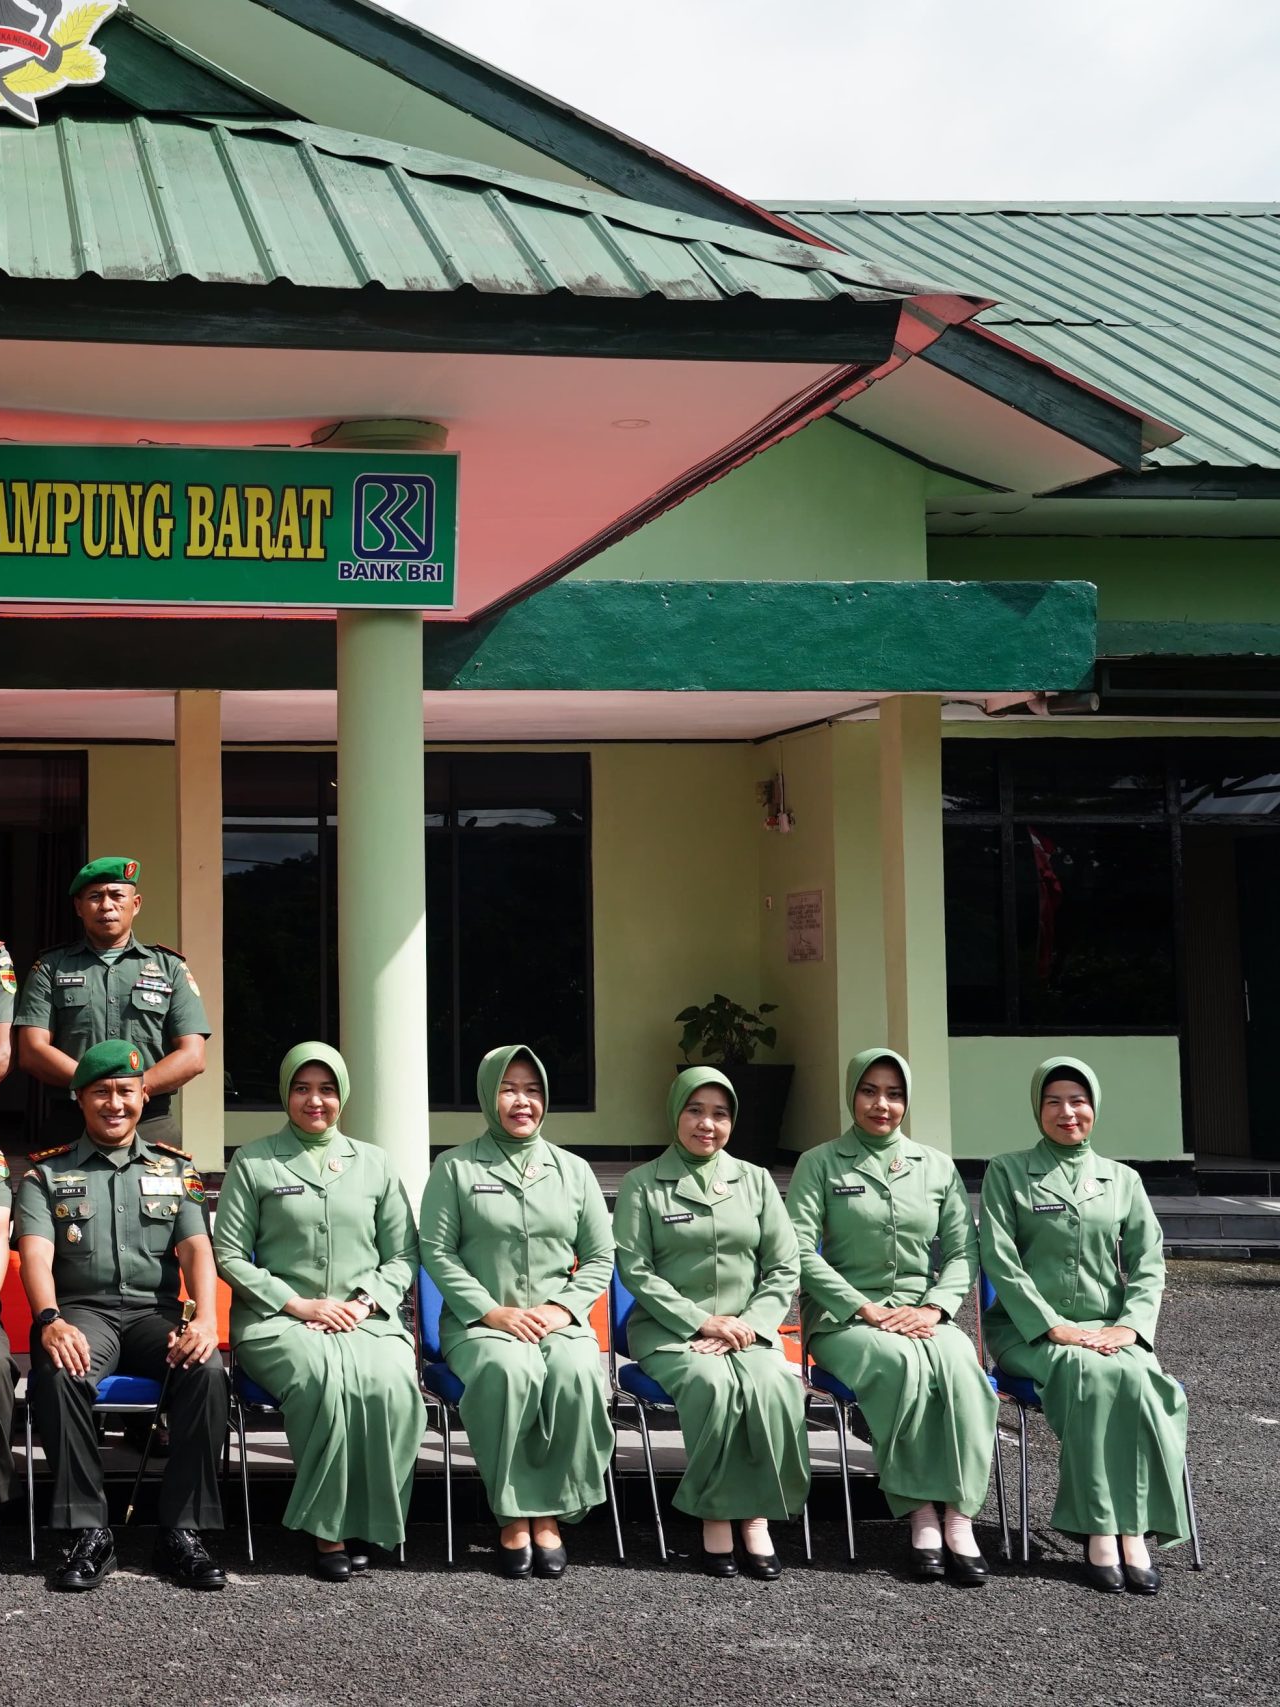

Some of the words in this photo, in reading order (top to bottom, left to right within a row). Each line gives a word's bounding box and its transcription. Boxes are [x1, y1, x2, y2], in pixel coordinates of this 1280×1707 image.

[184, 484, 332, 561] BARAT
[339, 561, 402, 580] BANK
[407, 562, 443, 581] BRI
